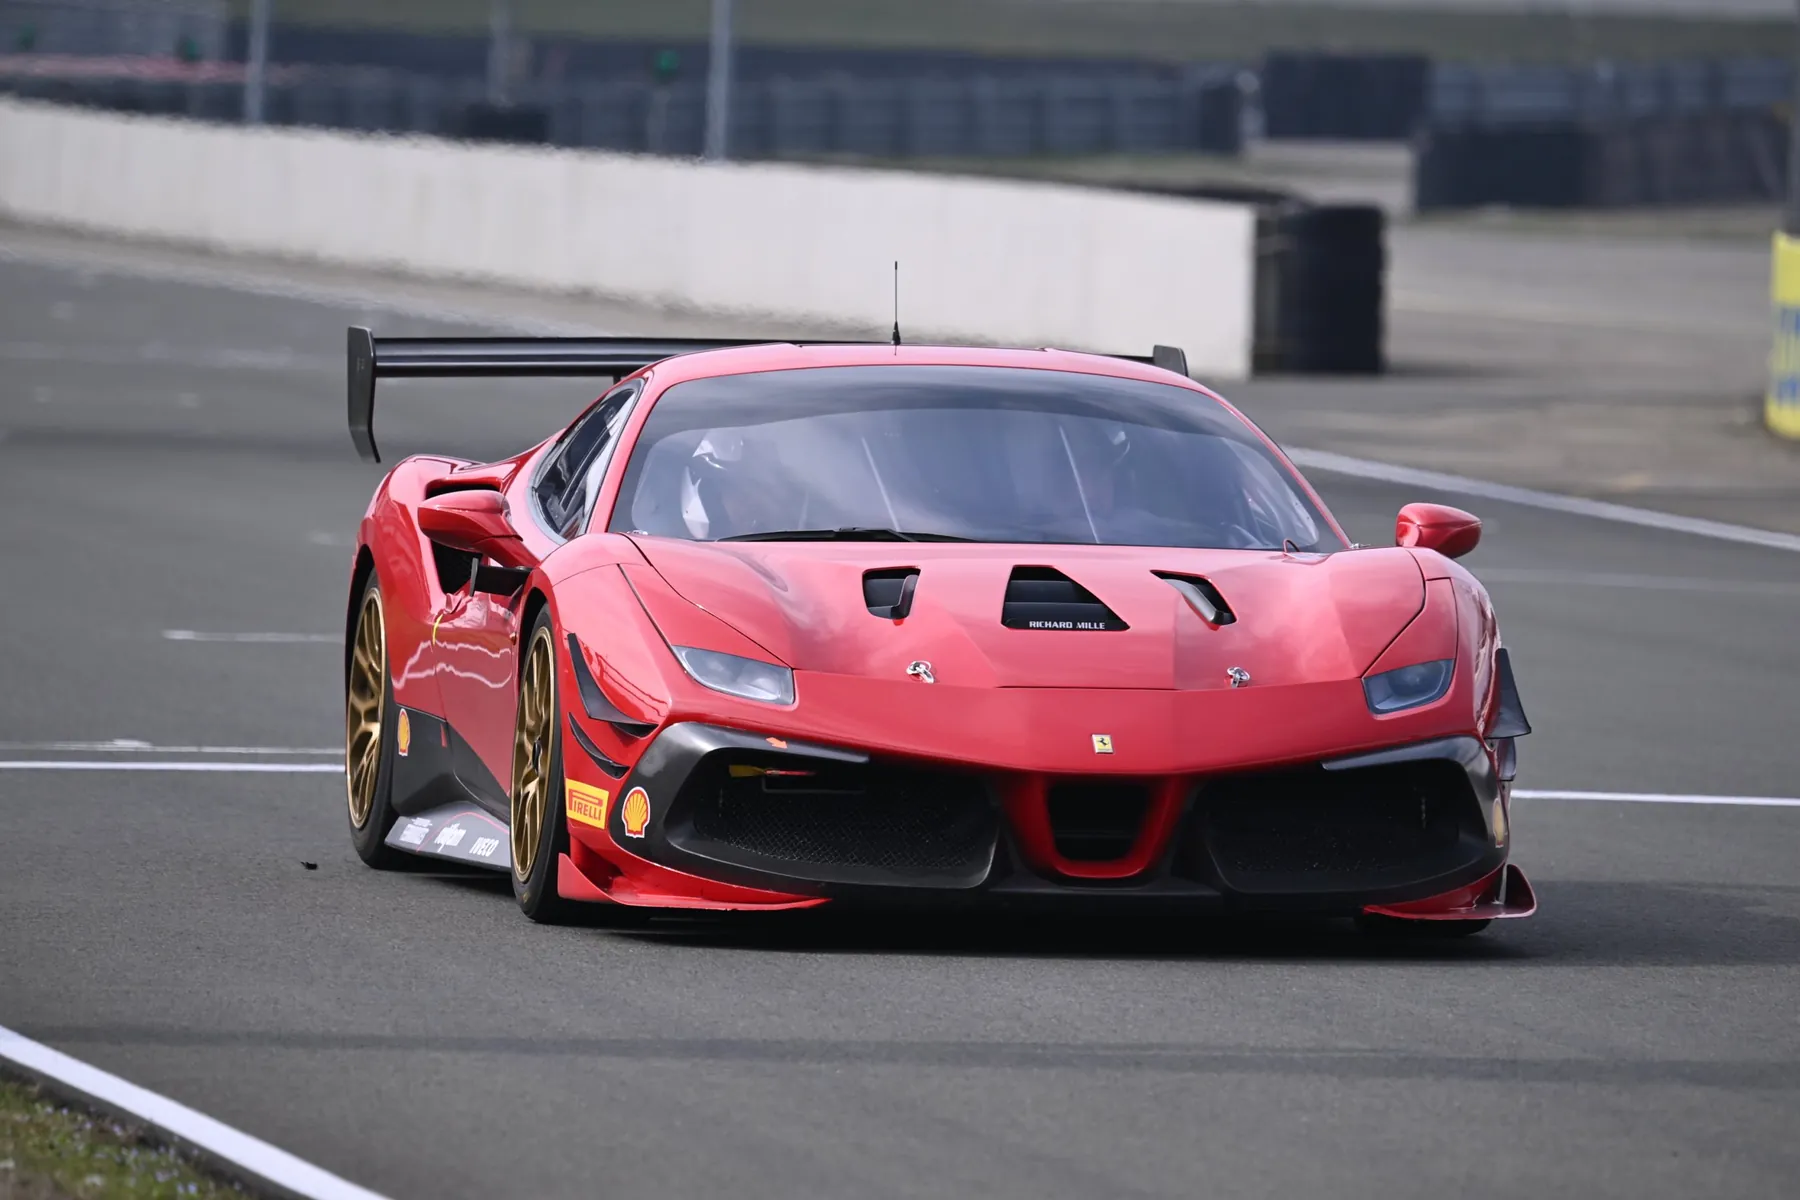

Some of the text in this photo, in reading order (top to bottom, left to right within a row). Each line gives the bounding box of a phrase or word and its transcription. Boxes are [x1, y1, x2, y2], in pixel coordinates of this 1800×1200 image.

[1029, 620, 1105, 630] RICHARD MILLE
[568, 788, 604, 821] PIRELLI
